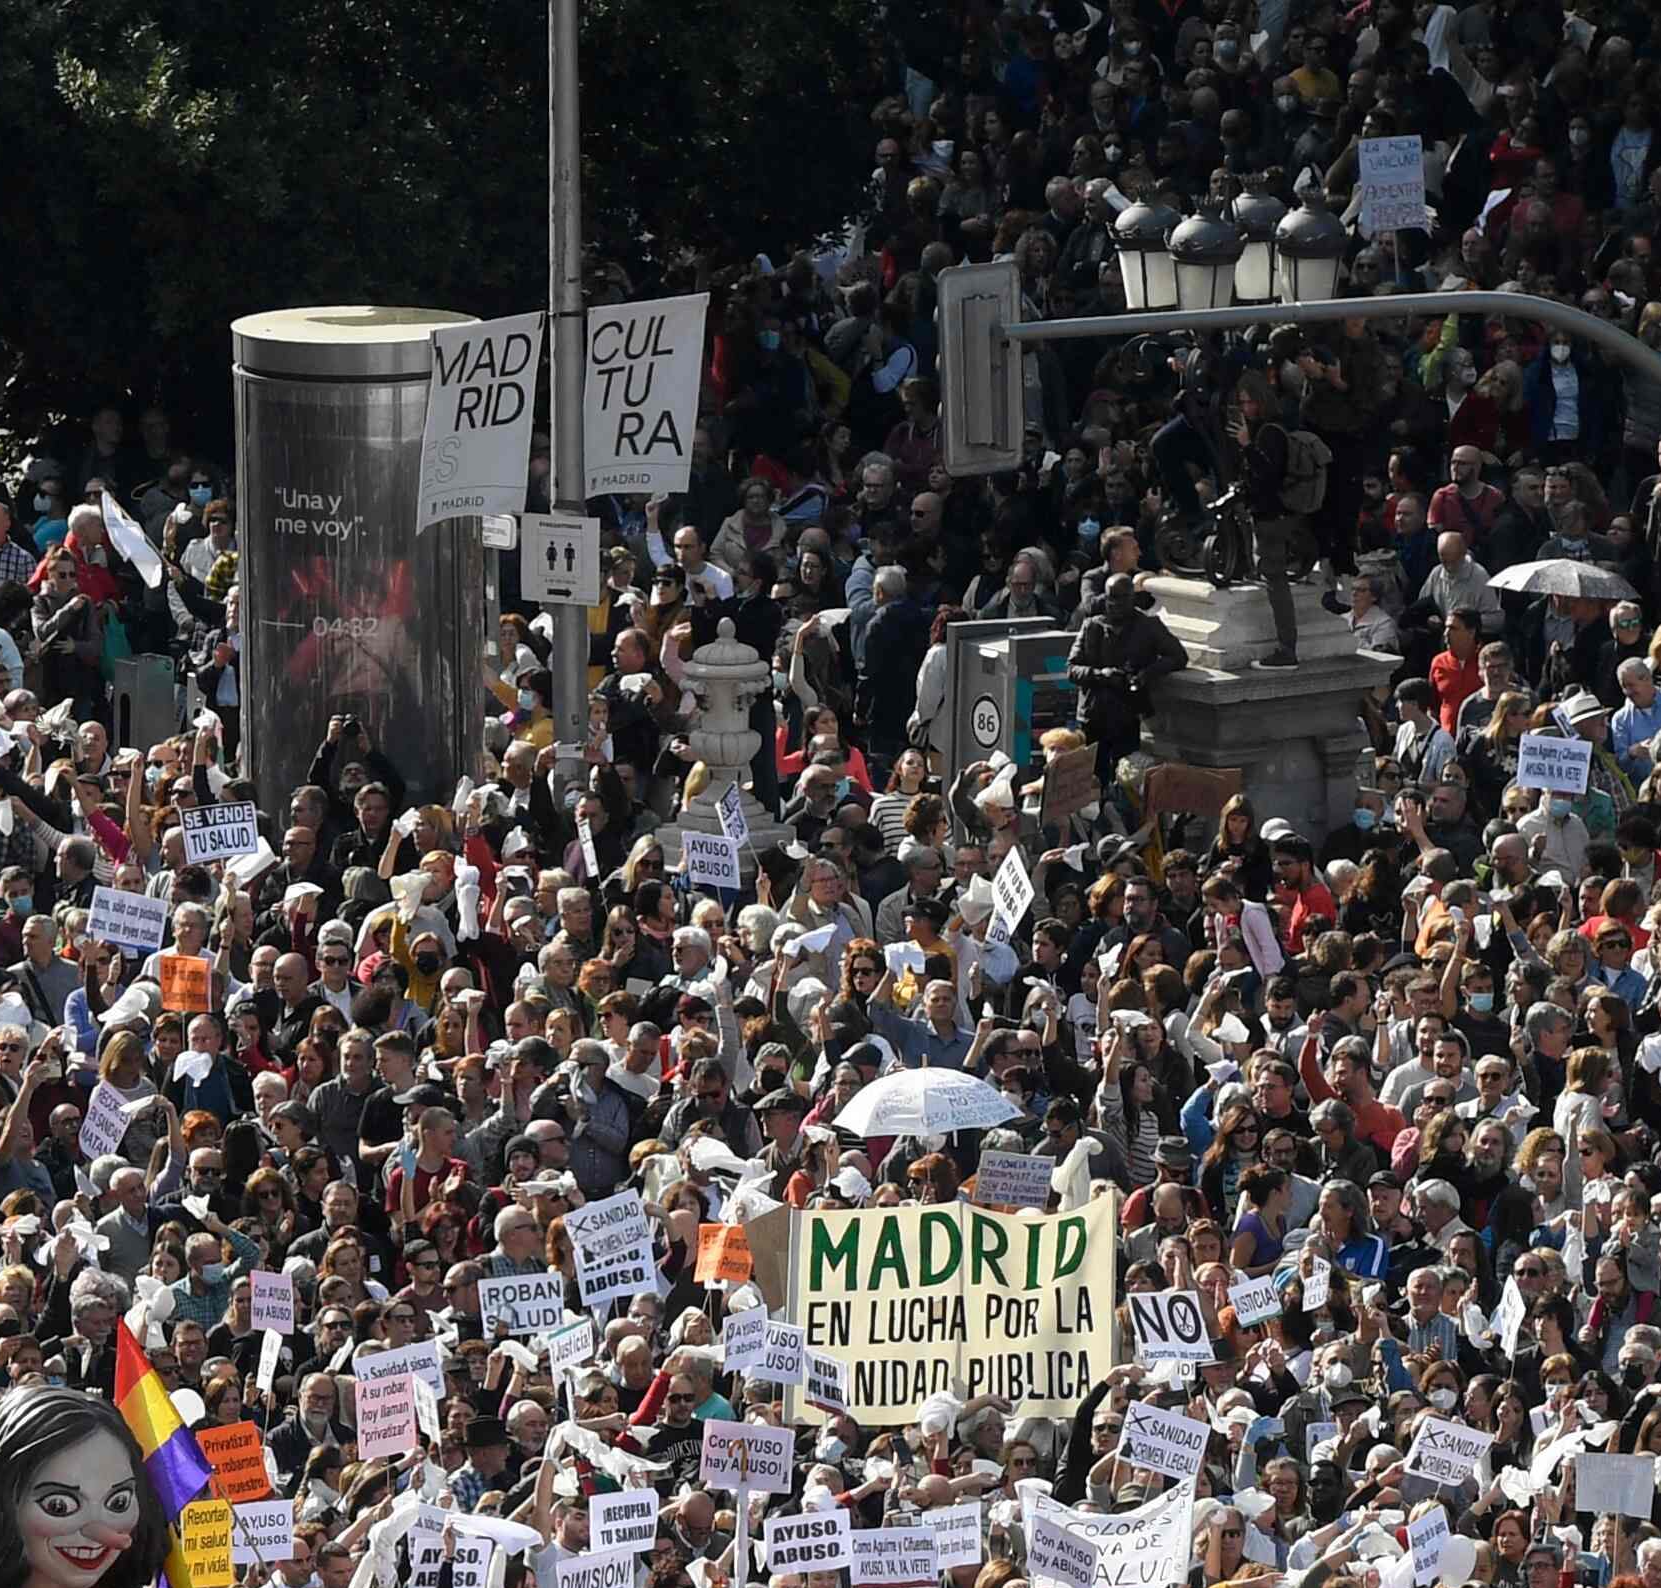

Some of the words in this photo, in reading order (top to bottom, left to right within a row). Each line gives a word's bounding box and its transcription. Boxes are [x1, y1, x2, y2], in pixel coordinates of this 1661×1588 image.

[591, 314, 674, 365] CUL
[596, 361, 655, 411] TU
[454, 381, 525, 432] RID
[614, 410, 683, 457] RA
[601, 472, 651, 486] MADRID
[327, 492, 342, 514] y
[441, 496, 485, 511] MADRID
[275, 518, 307, 534] me
[974, 709, 998, 735] 86
[185, 811, 203, 829] SE
[204, 804, 252, 824] VENDE
[191, 833, 208, 854] TU
[809, 1211, 1086, 1292] MADRID
[585, 1267, 651, 1296] ABUSO.
[483, 1280, 561, 1312] ¡ROBAN
[808, 1300, 851, 1346] EN
[869, 1295, 967, 1345] LUCHA
[986, 1293, 1039, 1339] POR
[1055, 1286, 1094, 1334] LA
[1131, 1294, 1202, 1344] NO
[361, 1386, 368, 1400] A
[370, 1388, 381, 1400] su
[362, 1408, 377, 1423] hoy
[379, 1402, 409, 1418] llaman
[203, 1432, 253, 1453] Privatizar
[603, 1502, 651, 1525] ¡RECUPERA
[185, 1537, 197, 1551] mi
[199, 1533, 228, 1550] salud
[601, 1530, 614, 1545] TU
[773, 1519, 843, 1545] AYUSO,
[773, 1542, 845, 1566] ABUSO.
[852, 1539, 872, 1554] Como
[873, 1538, 897, 1555] Aguirre
[1035, 1529, 1055, 1548] Con
[1057, 1540, 1093, 1567] AYUSO
[192, 1558, 205, 1573] mi
[860, 1561, 884, 1577] AYUSO,
[911, 1559, 931, 1573] VETE!
[1030, 1549, 1049, 1567] hay
[1052, 1559, 1091, 1586] ABUSO!
